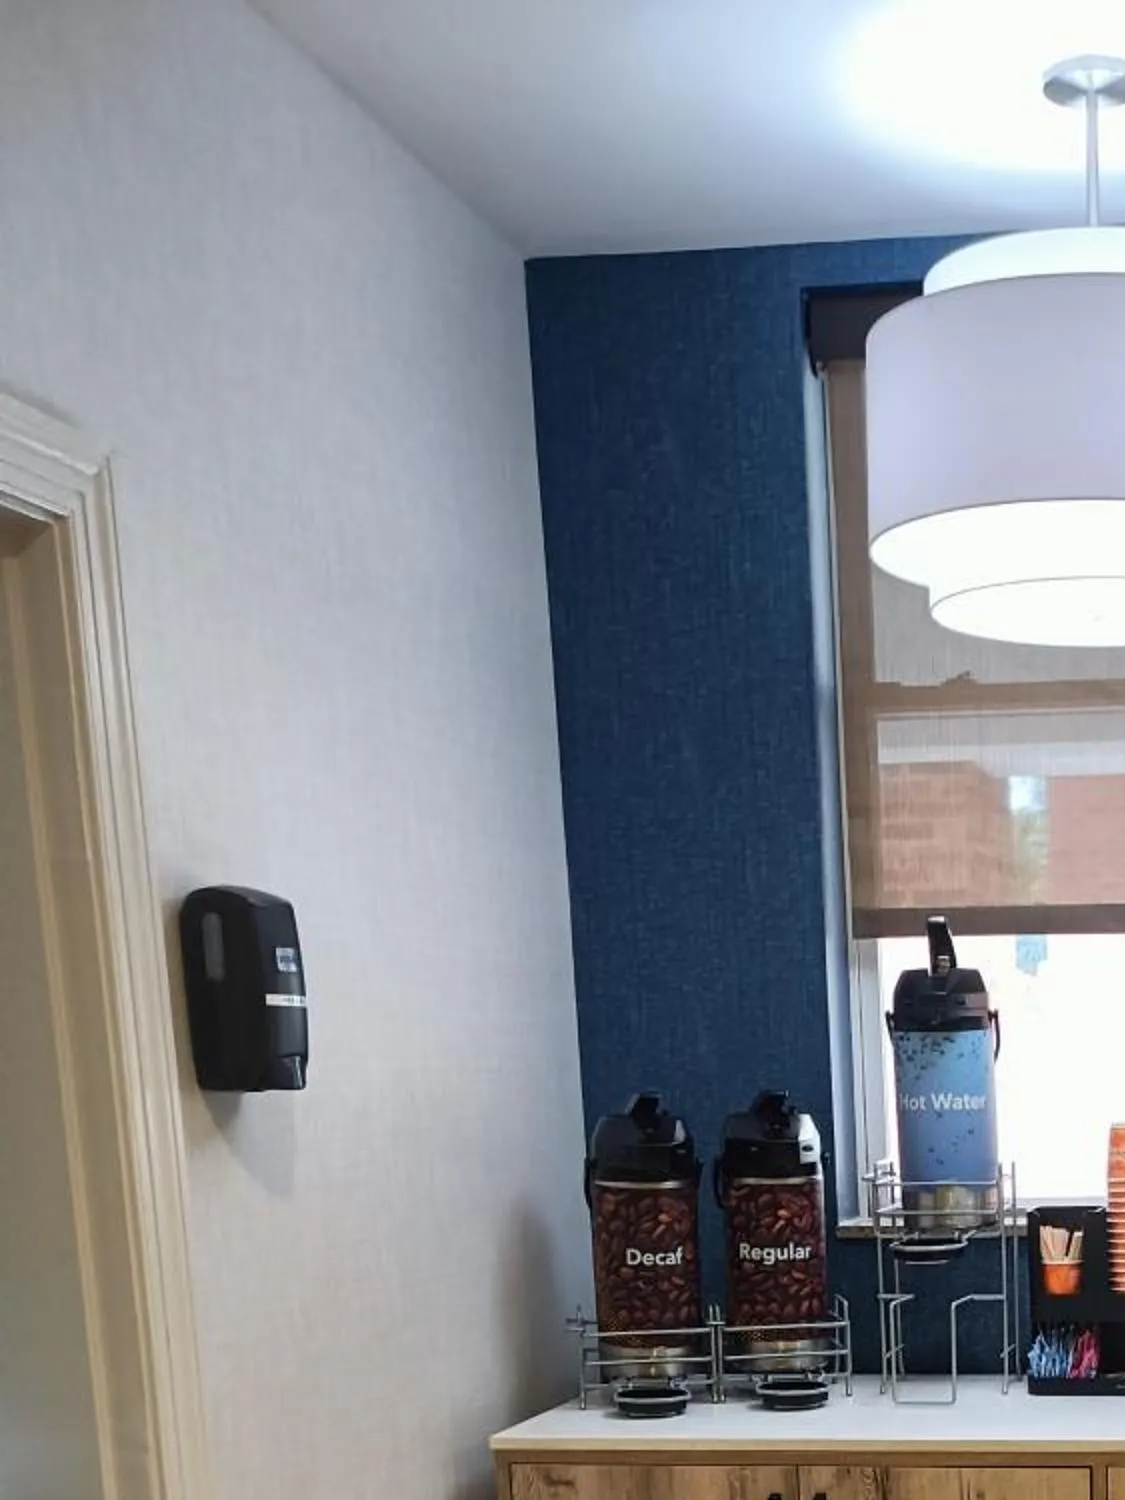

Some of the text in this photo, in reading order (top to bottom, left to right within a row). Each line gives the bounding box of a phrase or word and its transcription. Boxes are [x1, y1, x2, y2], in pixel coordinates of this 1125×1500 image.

[899, 1092, 986, 1112] Hot Water
[626, 1246, 684, 1265] Decaf
[739, 1242, 812, 1265] Regular
